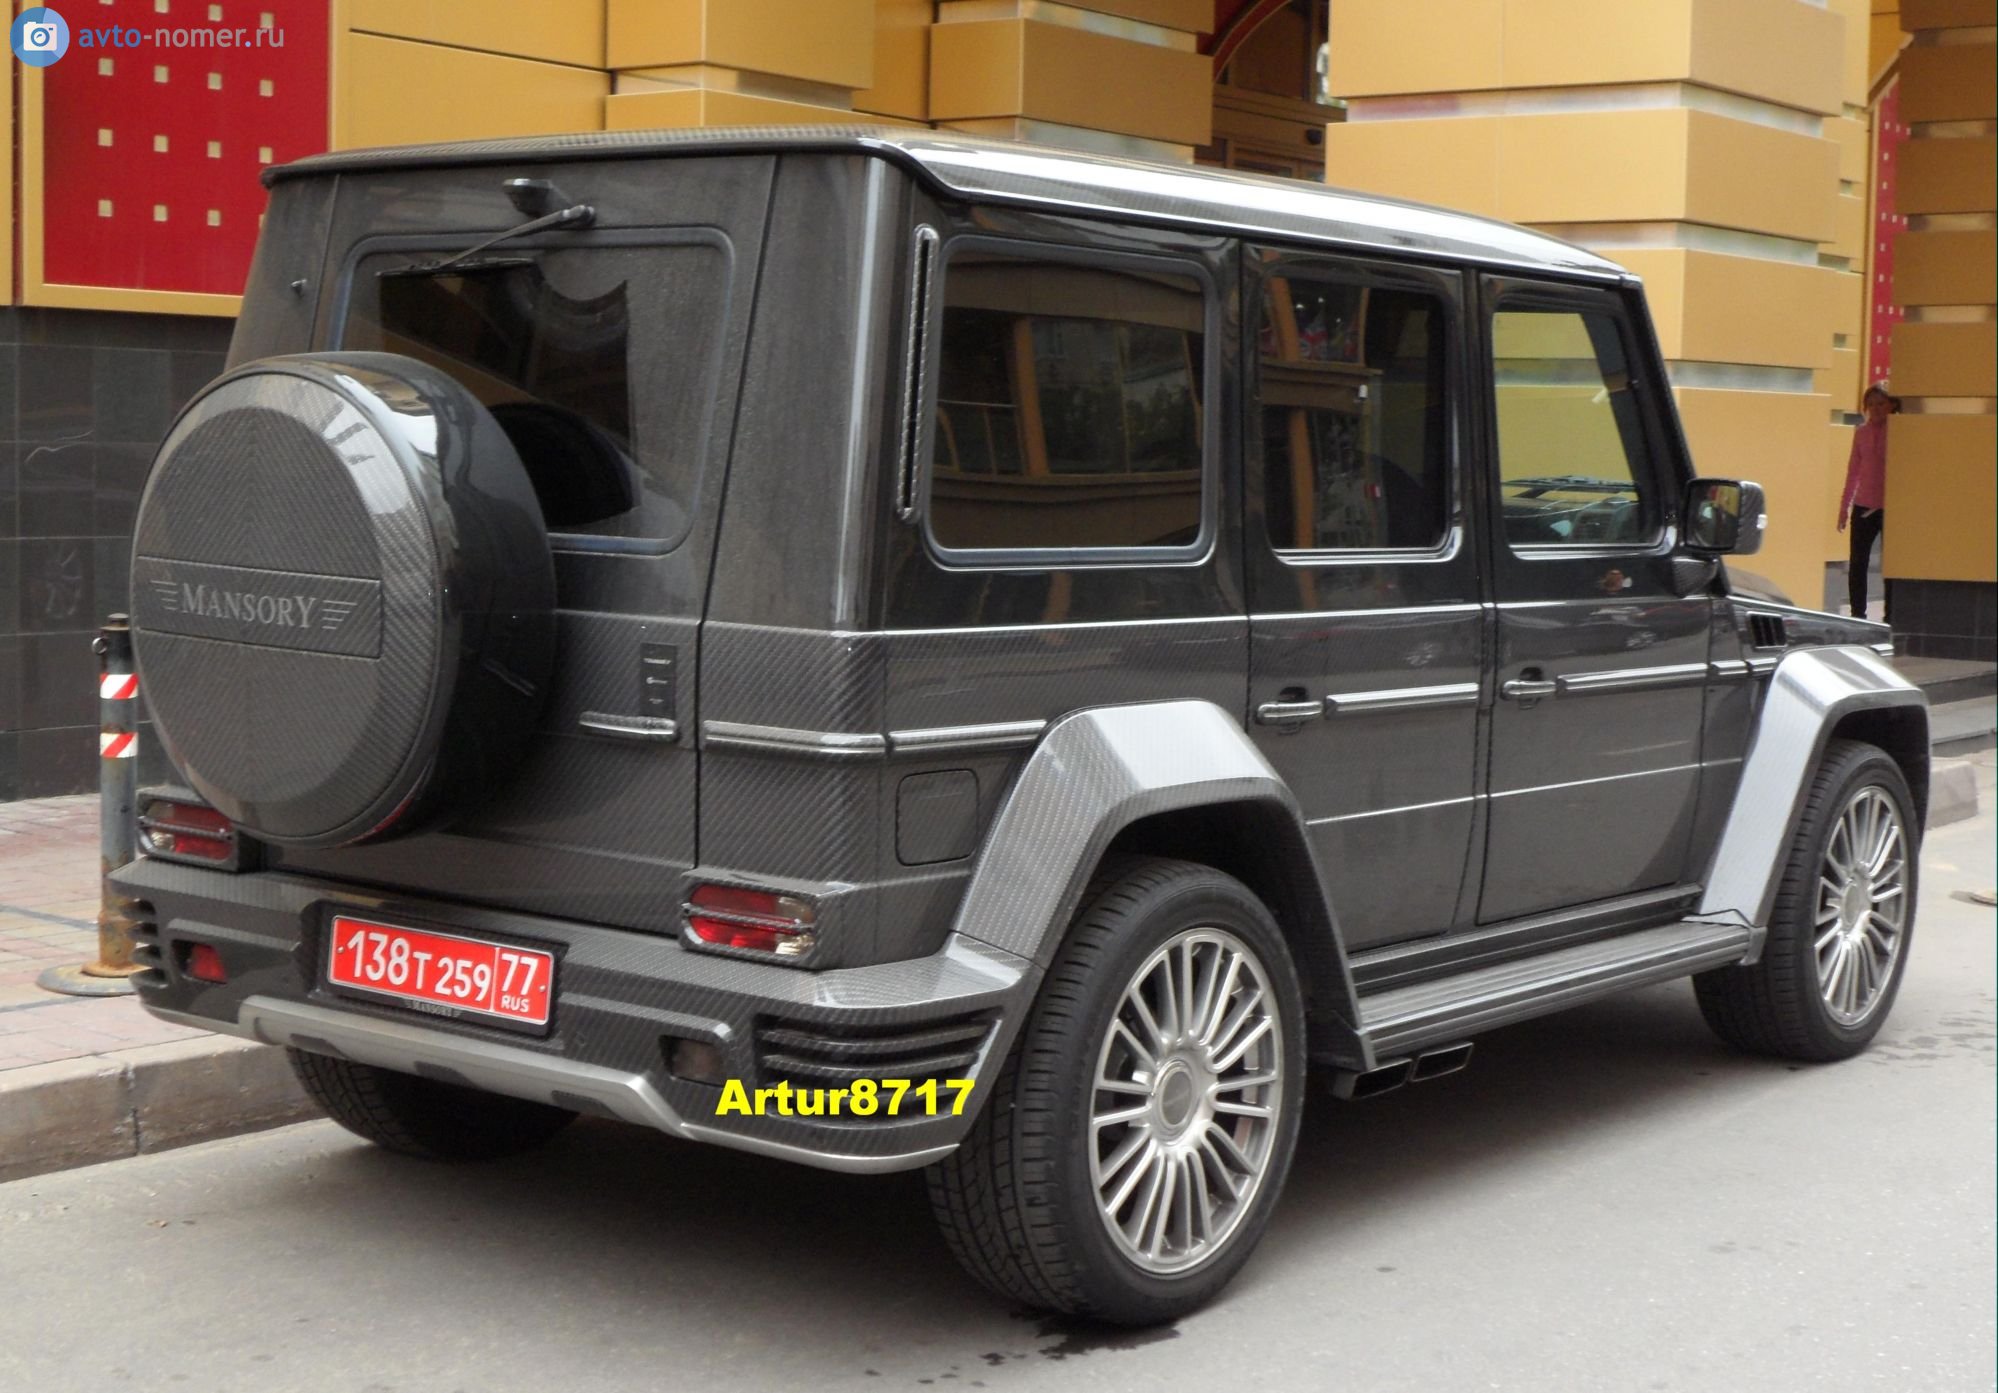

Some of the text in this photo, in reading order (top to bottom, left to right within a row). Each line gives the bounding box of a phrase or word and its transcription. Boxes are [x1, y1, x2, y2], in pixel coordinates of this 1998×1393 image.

[181, 582, 317, 629] MANSORY
[501, 952, 539, 996] 77
[501, 994, 530, 1013] RUS
